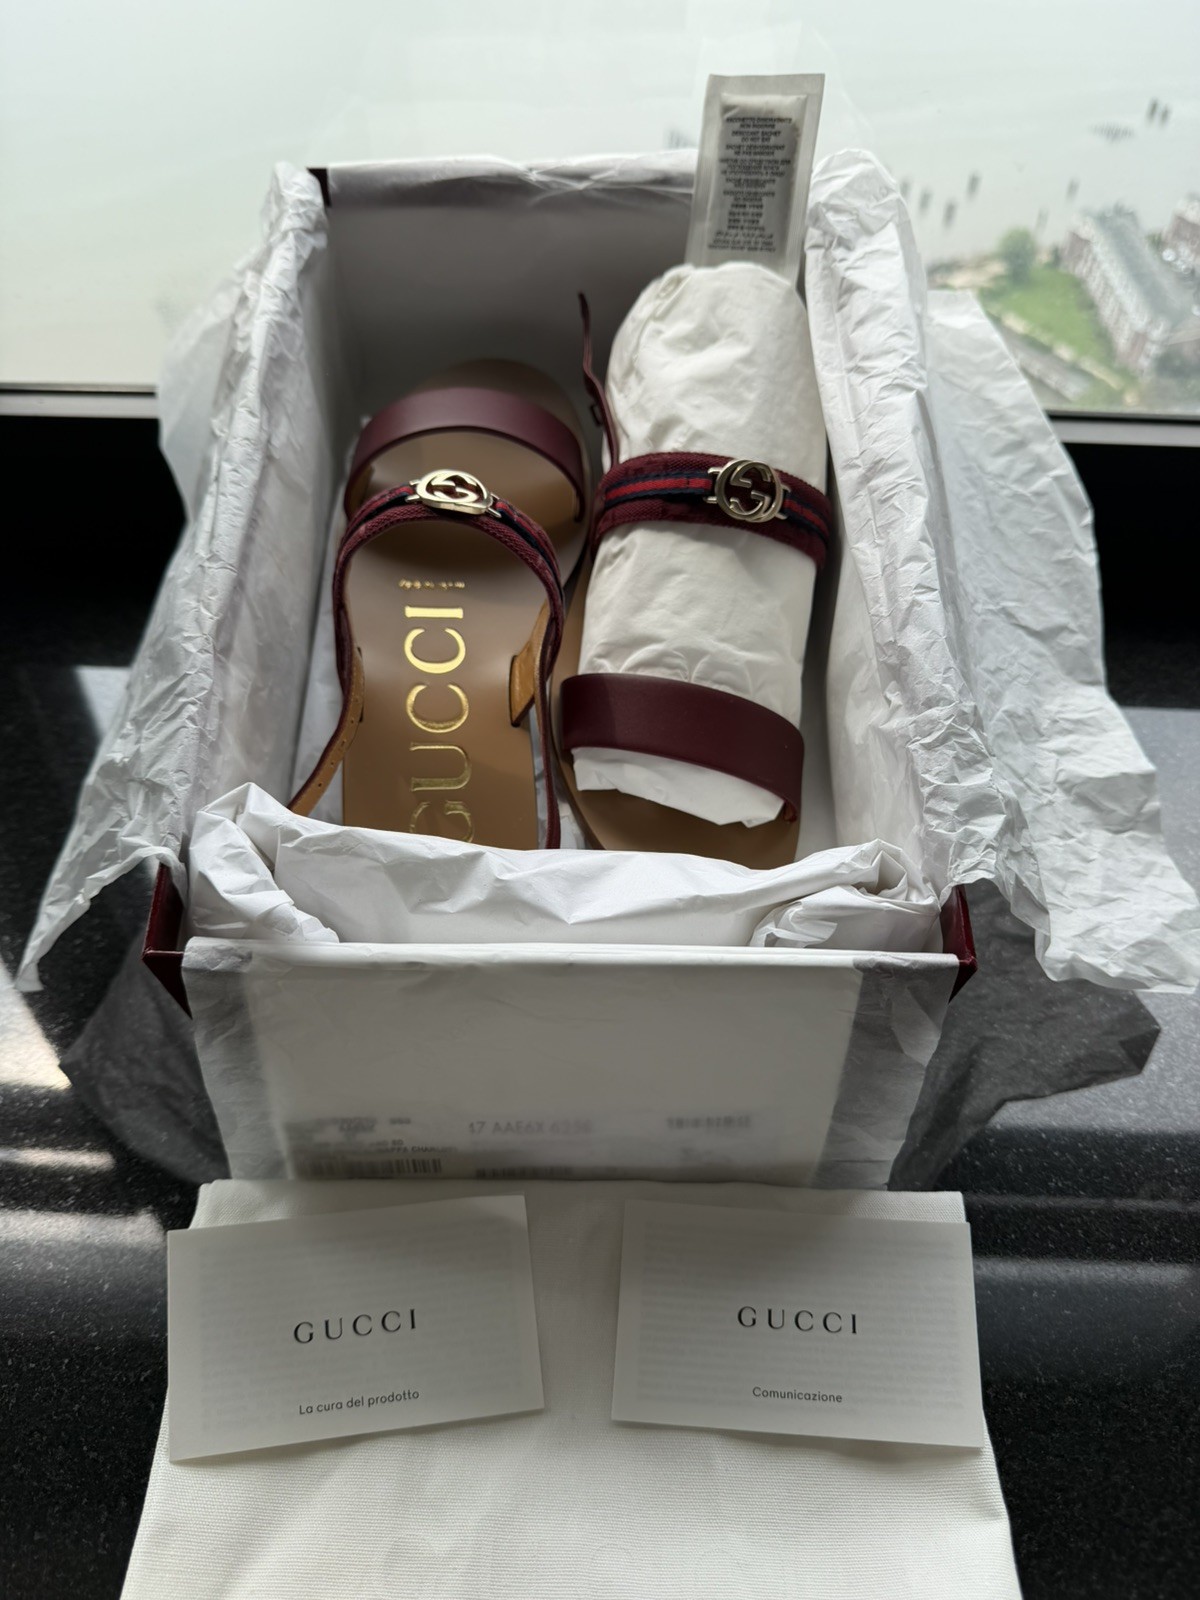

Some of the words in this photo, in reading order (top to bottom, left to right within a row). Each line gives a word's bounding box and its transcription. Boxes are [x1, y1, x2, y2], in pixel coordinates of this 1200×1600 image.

[293, 1308, 416, 1344] GUCCI
[737, 1305, 857, 1335] GUCCI
[299, 1405, 313, 1415] La
[316, 1401, 343, 1412] cura
[346, 1396, 364, 1408] del
[367, 1389, 420, 1407] prodotto
[752, 1386, 843, 1403] Comunicazione
